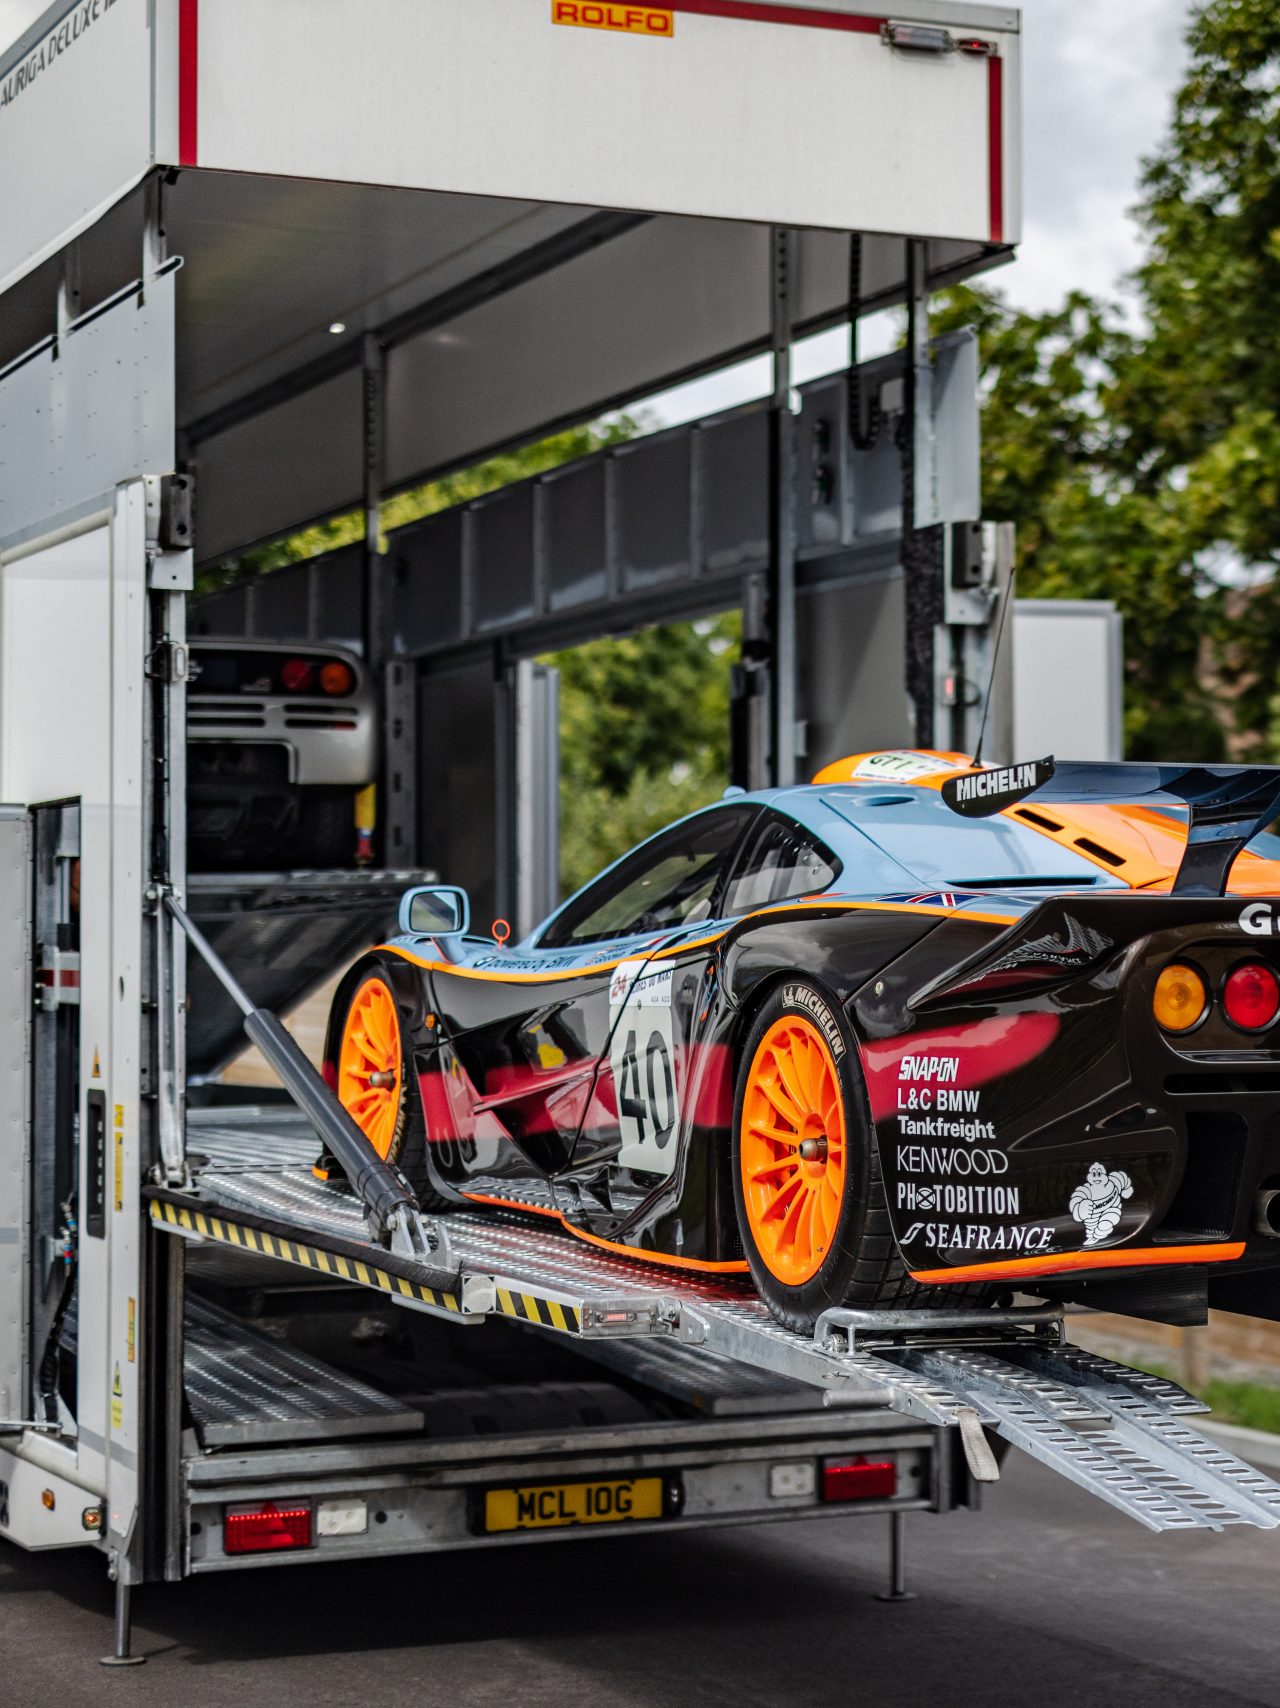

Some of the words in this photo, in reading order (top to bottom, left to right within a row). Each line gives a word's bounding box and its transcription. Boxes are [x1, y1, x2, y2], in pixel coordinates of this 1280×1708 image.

[556, 2, 669, 32] ROLFO
[0, 47, 46, 107] AURIGA
[48, 0, 100, 65] DELUXE
[956, 763, 1037, 802] MICHELIN
[611, 973, 627, 998] 24
[795, 986, 843, 1055] MICHELIN
[619, 1029, 676, 1150] 40
[897, 1088, 932, 1111] L&C
[937, 1089, 980, 1113] BMW
[897, 1115, 997, 1143] Tankfreight
[897, 1145, 1009, 1175] KENWOOD
[925, 1222, 1056, 1251] SEAFRANCE
[518, 1490, 576, 1522] MCL
